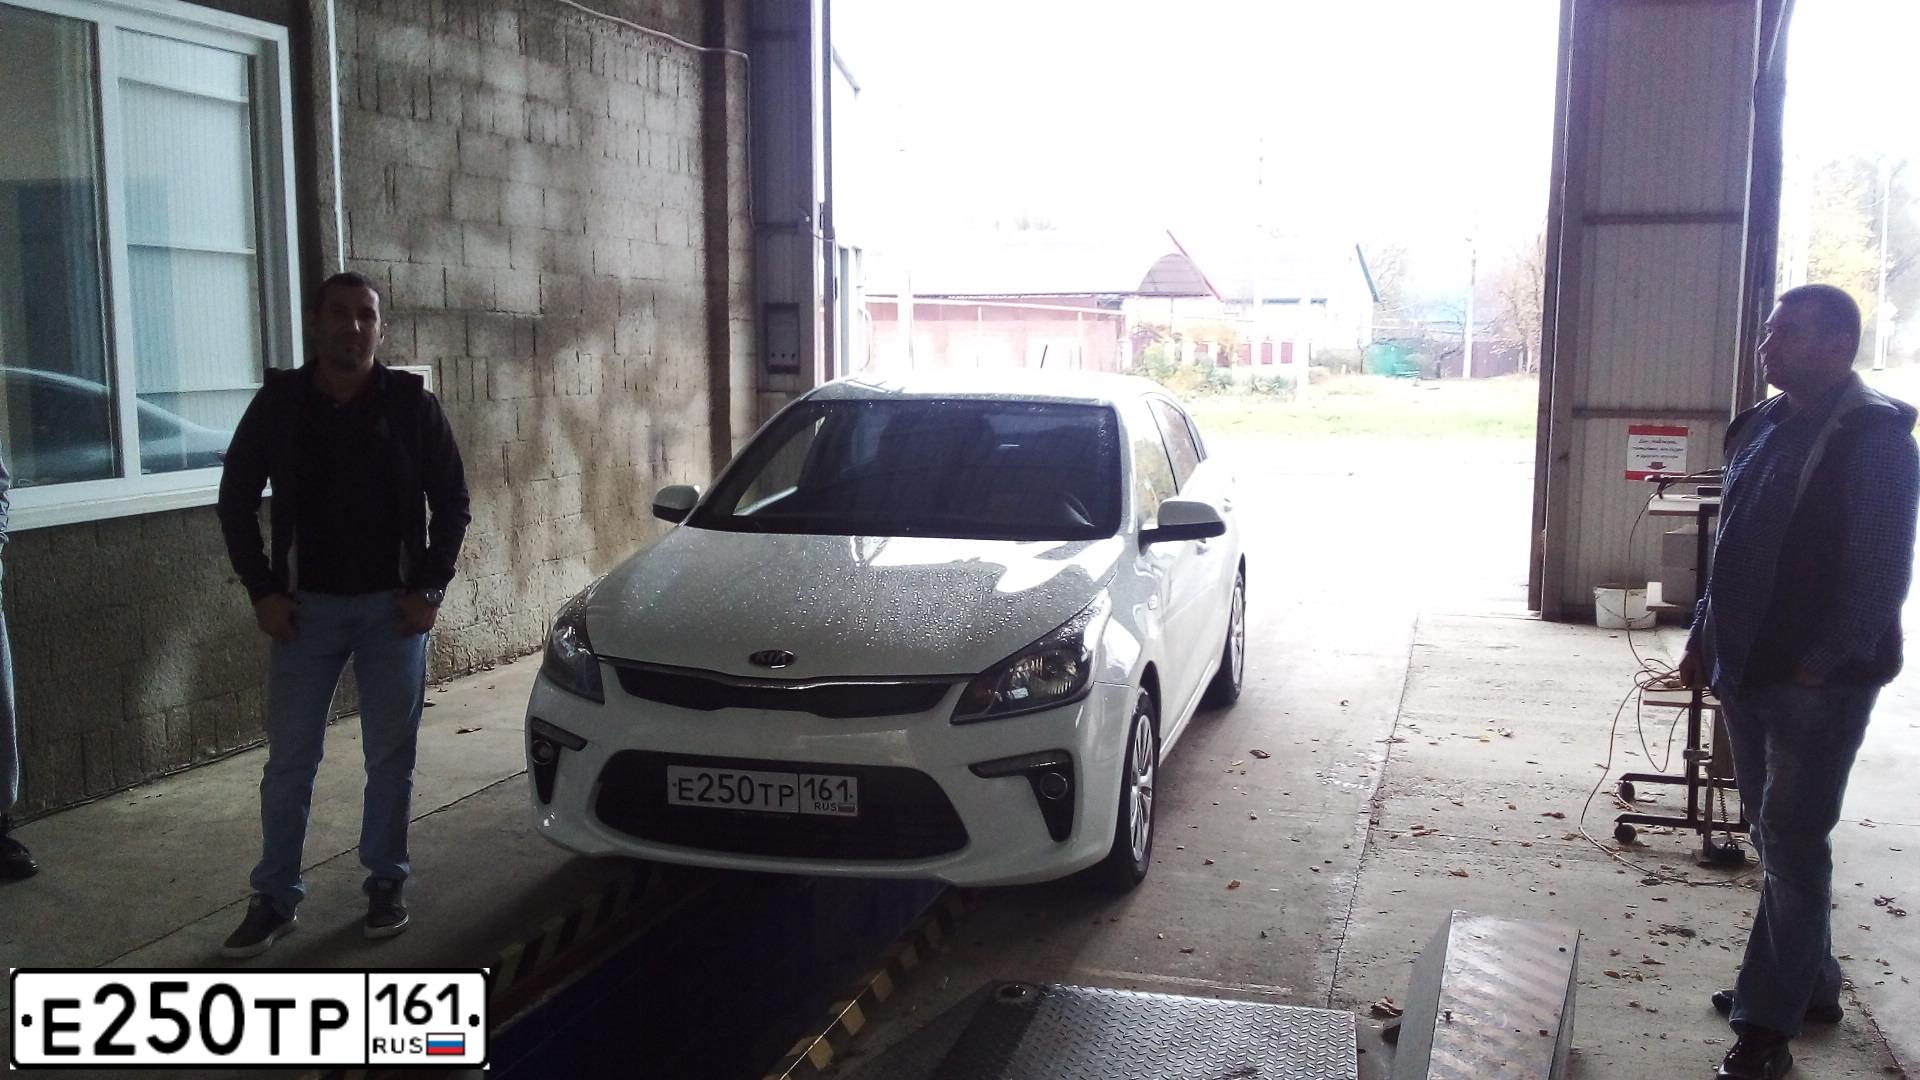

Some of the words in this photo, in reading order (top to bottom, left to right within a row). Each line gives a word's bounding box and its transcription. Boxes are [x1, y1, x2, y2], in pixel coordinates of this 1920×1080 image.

[755, 652, 787, 664] KIA
[804, 777, 849, 801] 161
[814, 802, 838, 811] RUS
